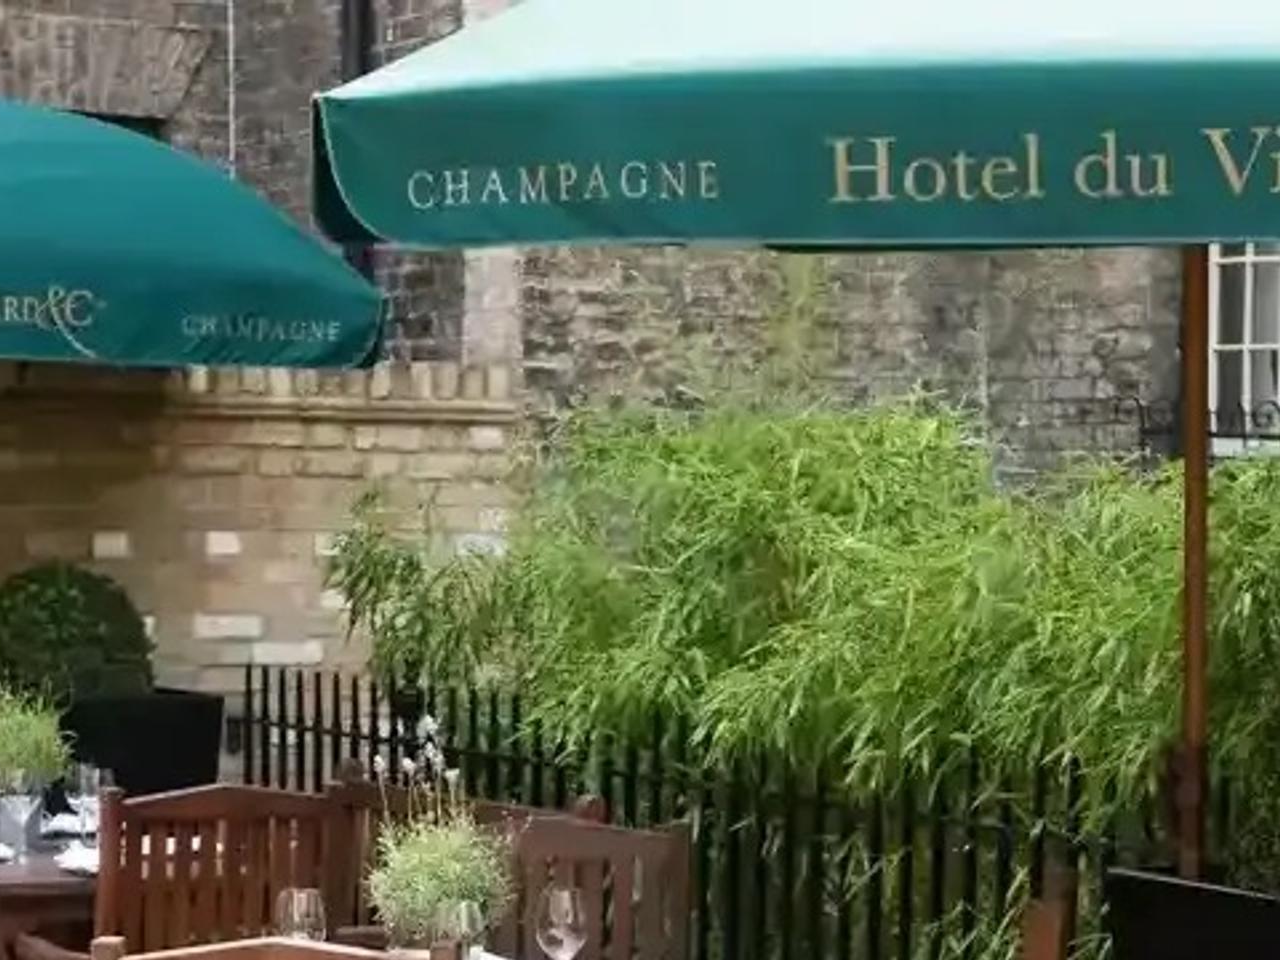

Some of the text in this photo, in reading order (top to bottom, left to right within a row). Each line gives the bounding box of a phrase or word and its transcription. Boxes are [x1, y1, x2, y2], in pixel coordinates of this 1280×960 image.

[406, 160, 720, 210] CHAMPAGNE
[824, 132, 1046, 202] Hotel
[1073, 129, 1174, 198] du
